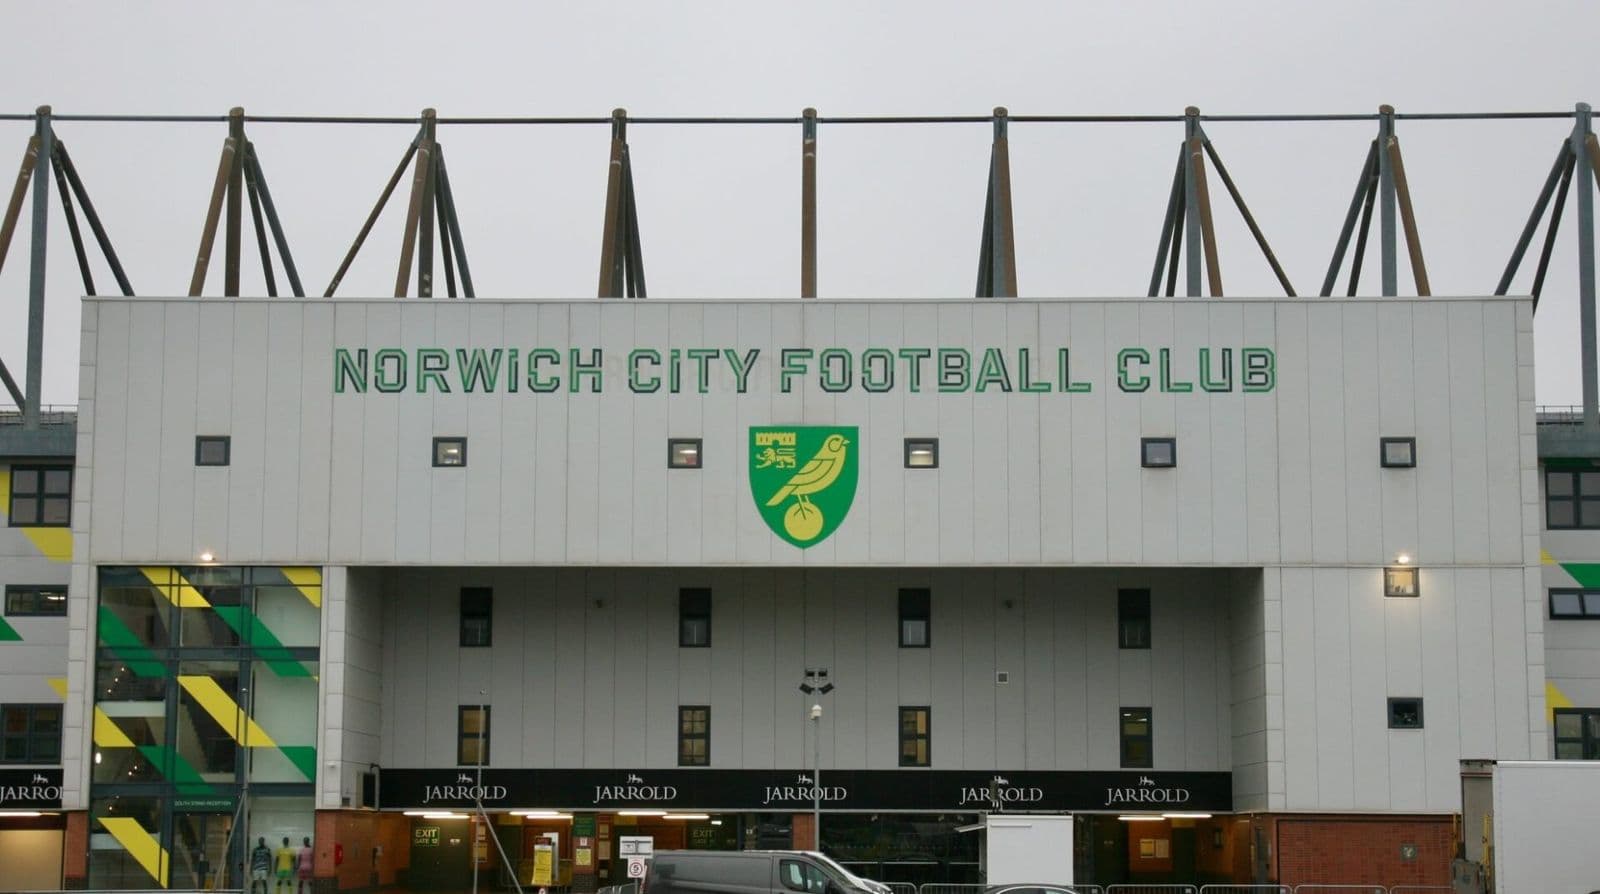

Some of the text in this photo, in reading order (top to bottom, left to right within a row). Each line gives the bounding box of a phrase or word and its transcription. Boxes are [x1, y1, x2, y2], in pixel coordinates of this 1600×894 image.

[334, 348, 1277, 393] NORWICH CITY FOOTBALL CLUB
[422, 785, 507, 804] JARROLD
[593, 785, 677, 804] JARROLD
[762, 786, 848, 805] JARROLD
[1104, 788, 1190, 806] JARROLD
[415, 829, 437, 838] EXIT
